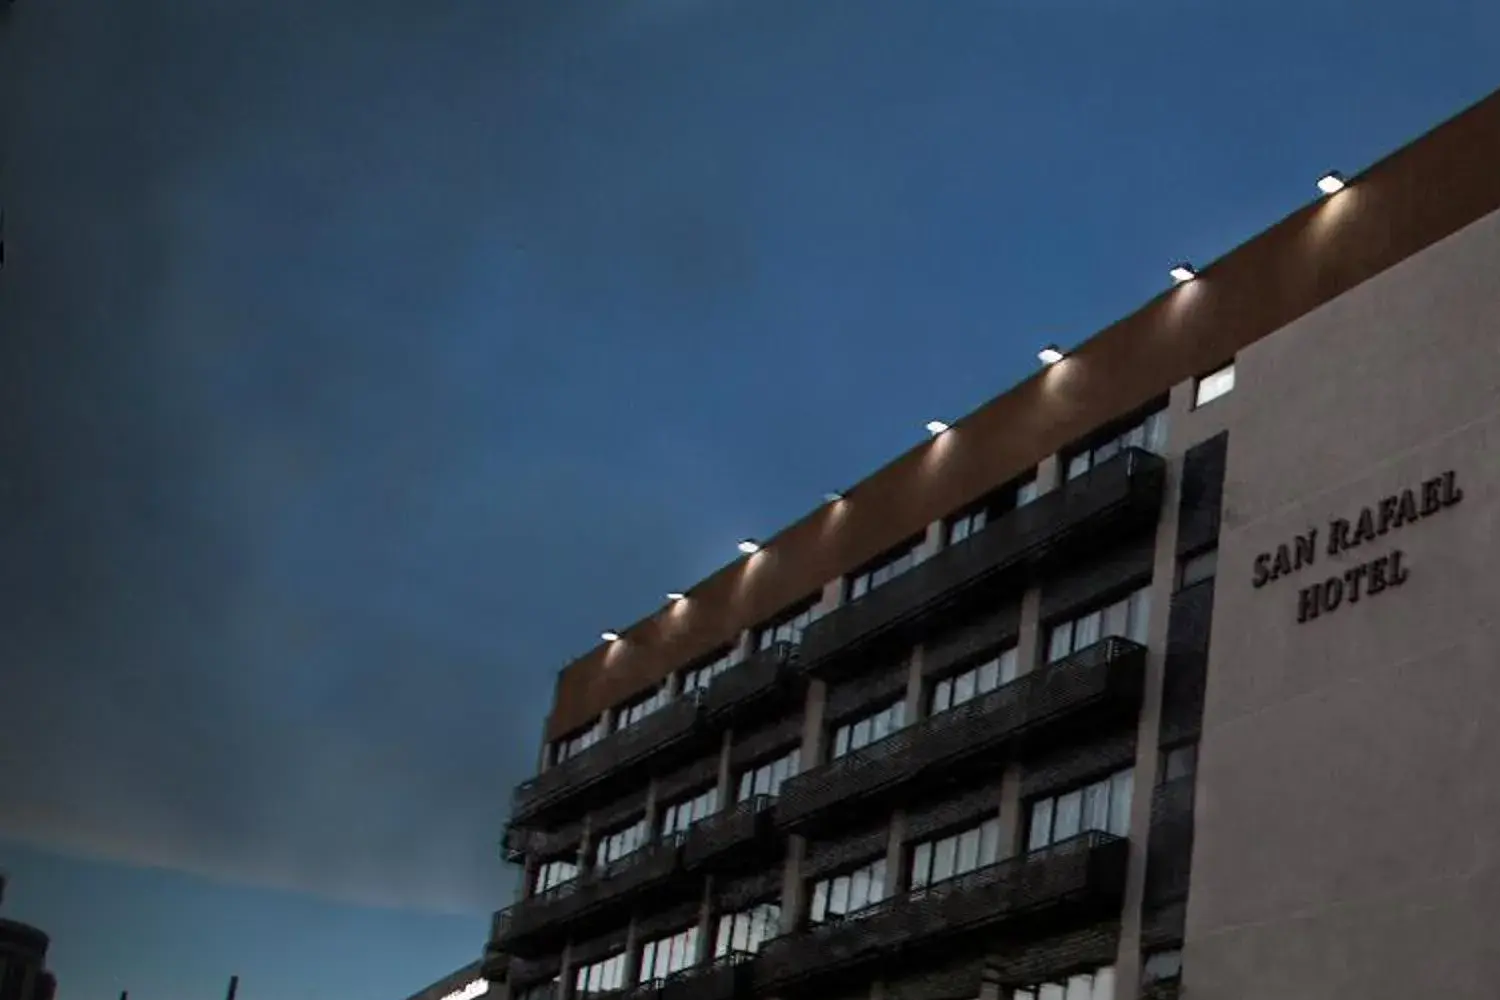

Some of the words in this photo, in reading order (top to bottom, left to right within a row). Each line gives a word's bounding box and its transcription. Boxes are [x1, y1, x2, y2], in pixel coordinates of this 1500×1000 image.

[1252, 527, 1318, 589] SAN
[1327, 470, 1463, 555] RAFAEL
[1297, 549, 1410, 624] HOTEL
